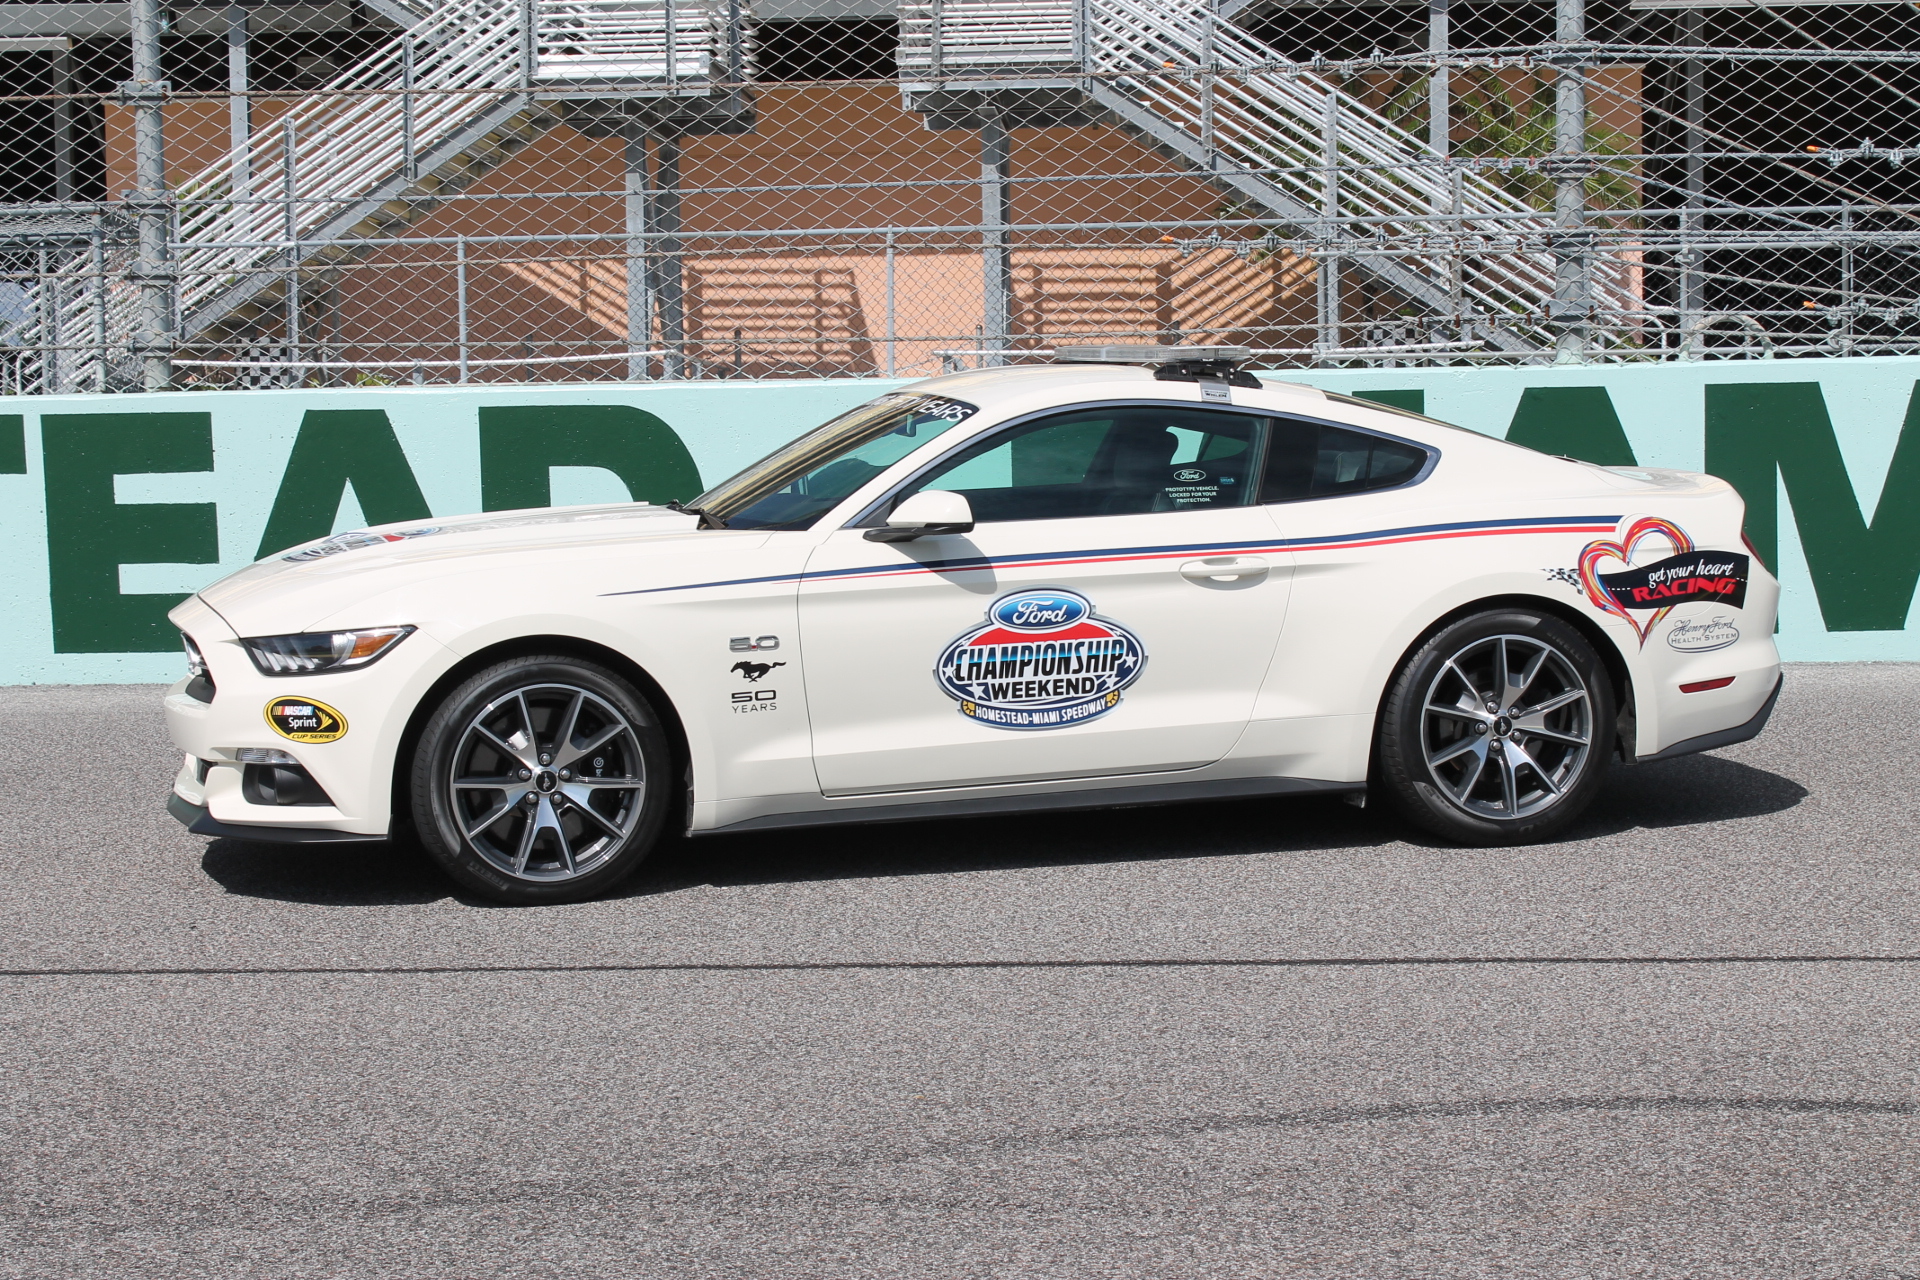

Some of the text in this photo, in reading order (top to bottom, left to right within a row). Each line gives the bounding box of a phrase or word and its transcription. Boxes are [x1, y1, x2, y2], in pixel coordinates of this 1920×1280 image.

[913, 399, 972, 421] YEARS
[1180, 470, 1200, 480] Ford
[1648, 559, 1734, 589] get your heart
[1631, 577, 1739, 602] RACING
[1012, 600, 1067, 624] Ford
[1673, 616, 1735, 637] Henry Ford
[729, 635, 780, 653] 5.0
[1671, 633, 1737, 645] HEALTH SYSTEM
[955, 639, 1125, 682] CHAMPIONSHIP
[731, 690, 776, 704] 50
[991, 677, 1096, 700] WEEKEND
[284, 706, 312, 715] NASCAR
[732, 702, 777, 714] YEARS
[975, 697, 1107, 725] HOMESTEAD-MIAMI SPEEDWAY
[288, 717, 317, 729] Sprint
